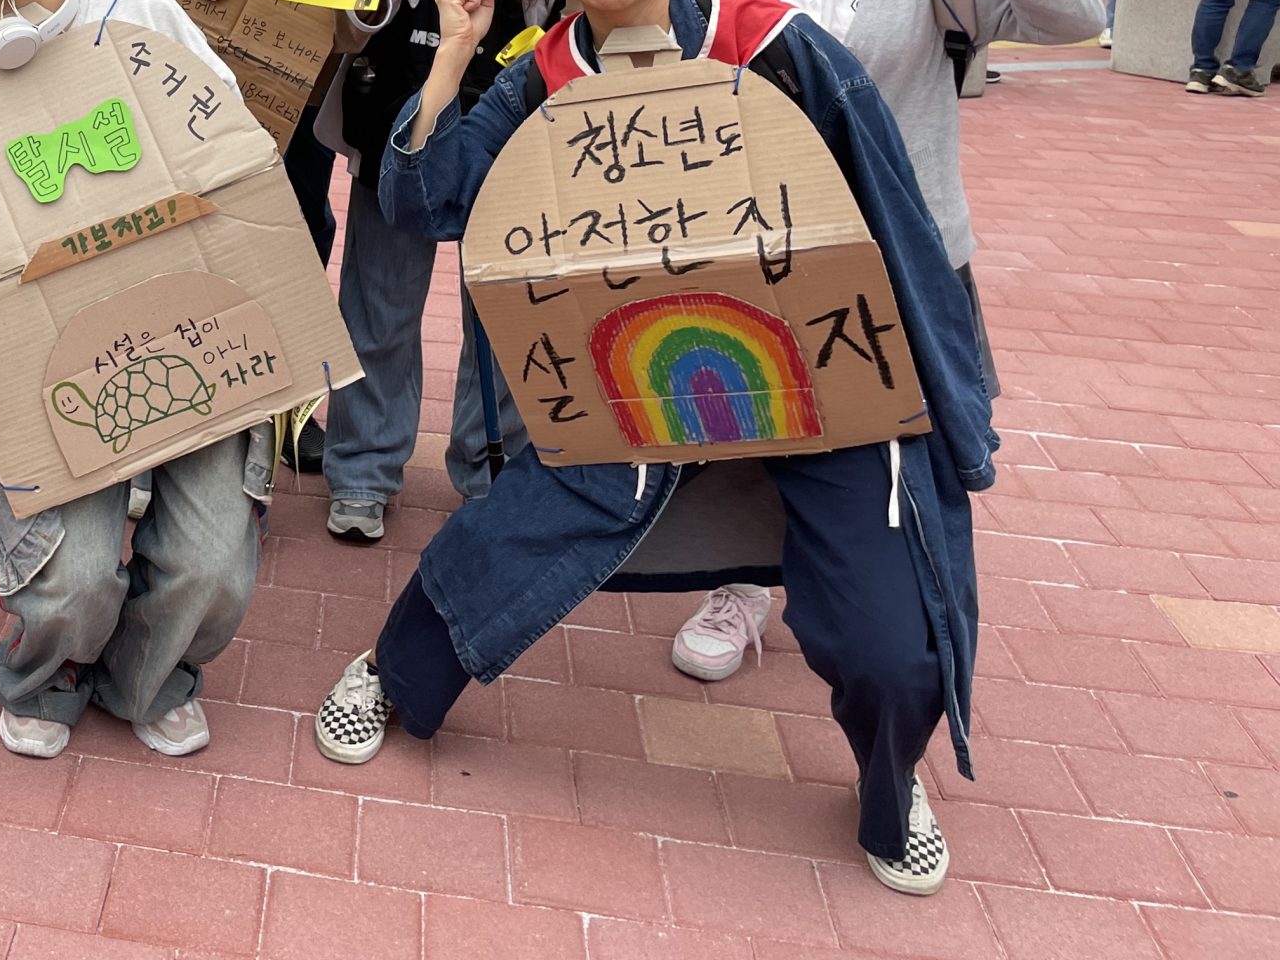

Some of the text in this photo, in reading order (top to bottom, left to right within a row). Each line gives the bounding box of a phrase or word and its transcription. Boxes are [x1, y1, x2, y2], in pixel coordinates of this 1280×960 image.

[126, 40, 223, 142] 주거권
[8, 98, 140, 200] 탈시설
[566, 104, 744, 184] 청소년도
[503, 181, 793, 307] 안전한 집
[94, 315, 220, 376] 시설은 집이
[201, 331, 250, 366] 아니
[219, 351, 278, 391] 자라
